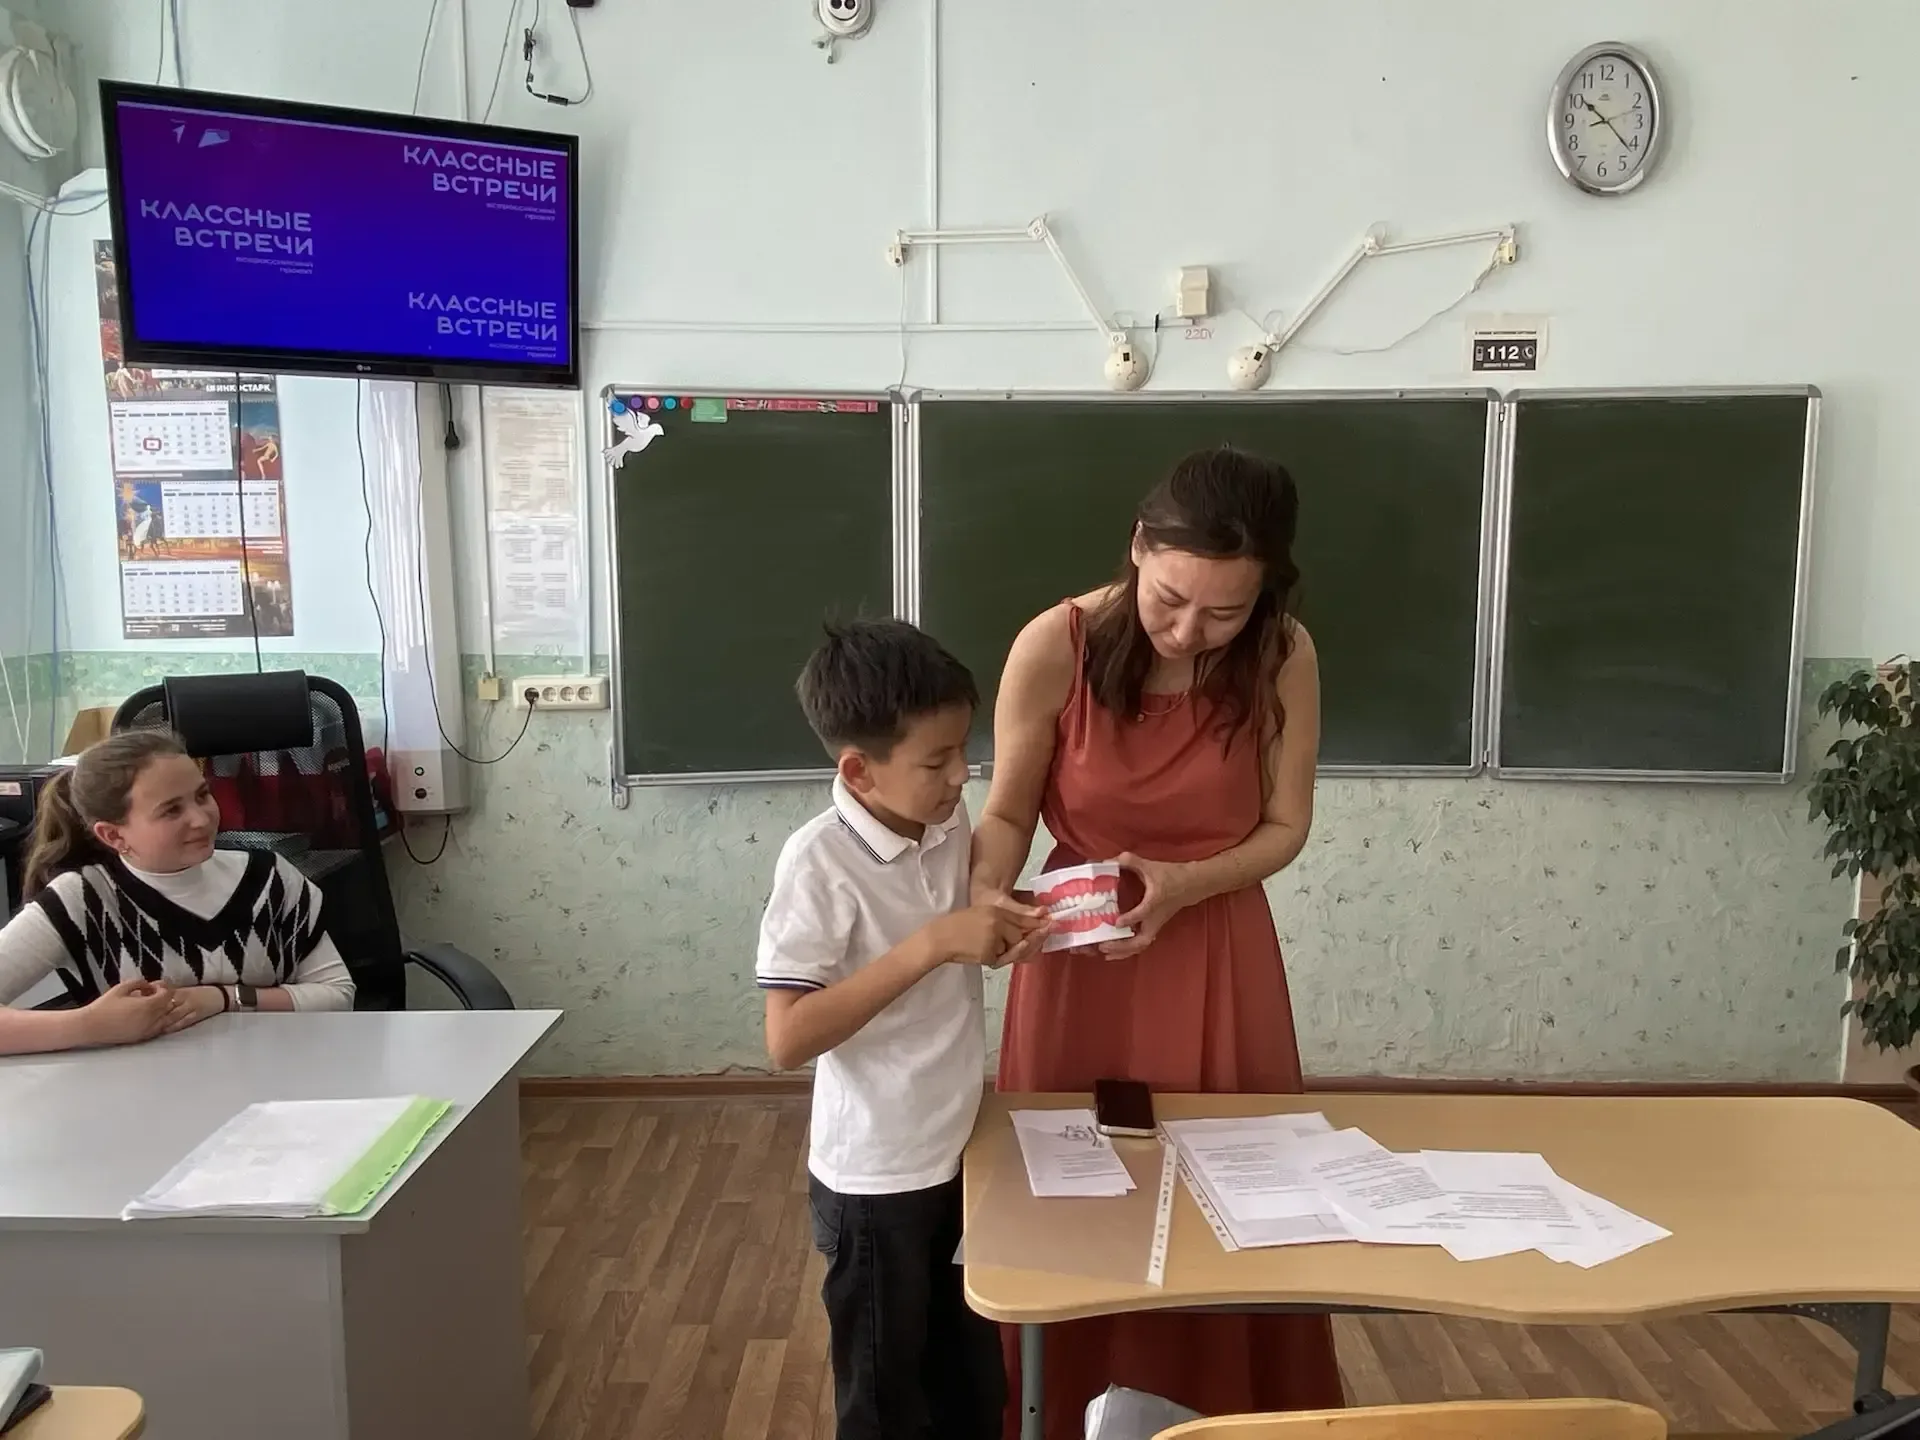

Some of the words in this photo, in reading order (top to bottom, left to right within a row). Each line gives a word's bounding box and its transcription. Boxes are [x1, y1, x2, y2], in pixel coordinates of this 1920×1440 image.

[1599, 64, 1615, 81] 12
[1581, 73, 1594, 89] 11
[1624, 73, 1630, 89] 1
[1568, 93, 1584, 109] 10
[1632, 92, 1642, 109] 2
[1565, 113, 1575, 129] 9
[1635, 113, 1644, 129] 3
[1568, 134, 1578, 151] 8
[1629, 135, 1639, 151] 4
[403, 144, 557, 180] КЛАССНЫЕ
[1577, 155, 1588, 171] 7
[1597, 161, 1607, 177] 6
[1618, 155, 1628, 171] 5
[432, 172, 557, 203] ВСТРЕЧИ
[140, 199, 312, 232] КЛАССНЫЕ
[174, 226, 313, 256] ВСТРЕЧИ
[408, 291, 557, 320] КЛАССНЫЕ
[437, 316, 558, 341] ВСТРЕЧИ
[1487, 345, 1519, 360] 112
